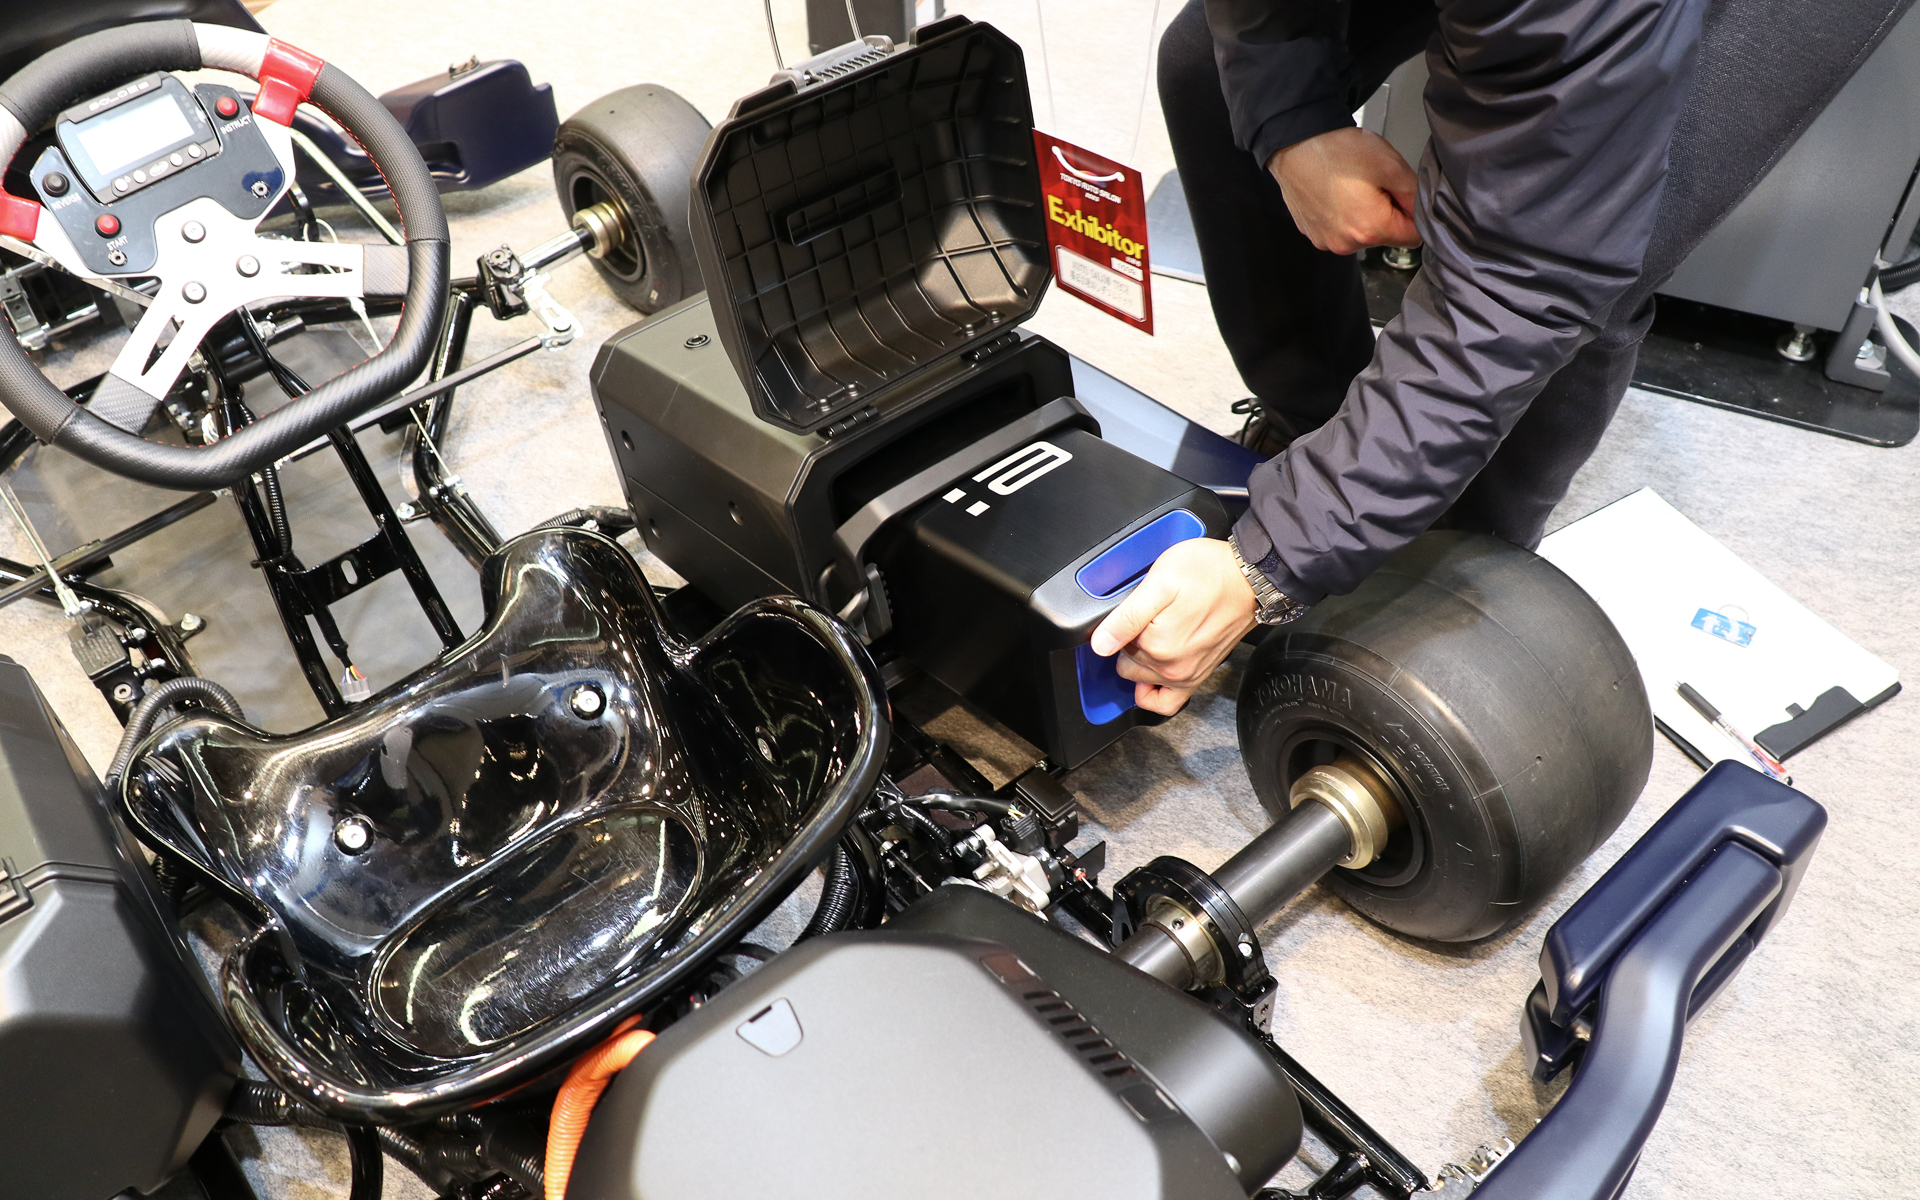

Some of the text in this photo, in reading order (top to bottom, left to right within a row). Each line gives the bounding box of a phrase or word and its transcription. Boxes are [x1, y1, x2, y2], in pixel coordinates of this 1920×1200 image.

[220, 114, 251, 134] INSTRUCT
[50, 192, 82, 211] REVERSE
[1048, 194, 1145, 259] Exhibitor
[106, 235, 128, 251] START
[1254, 674, 1352, 710] YOKOHAMA
[1410, 743, 1450, 792] ROTATION
